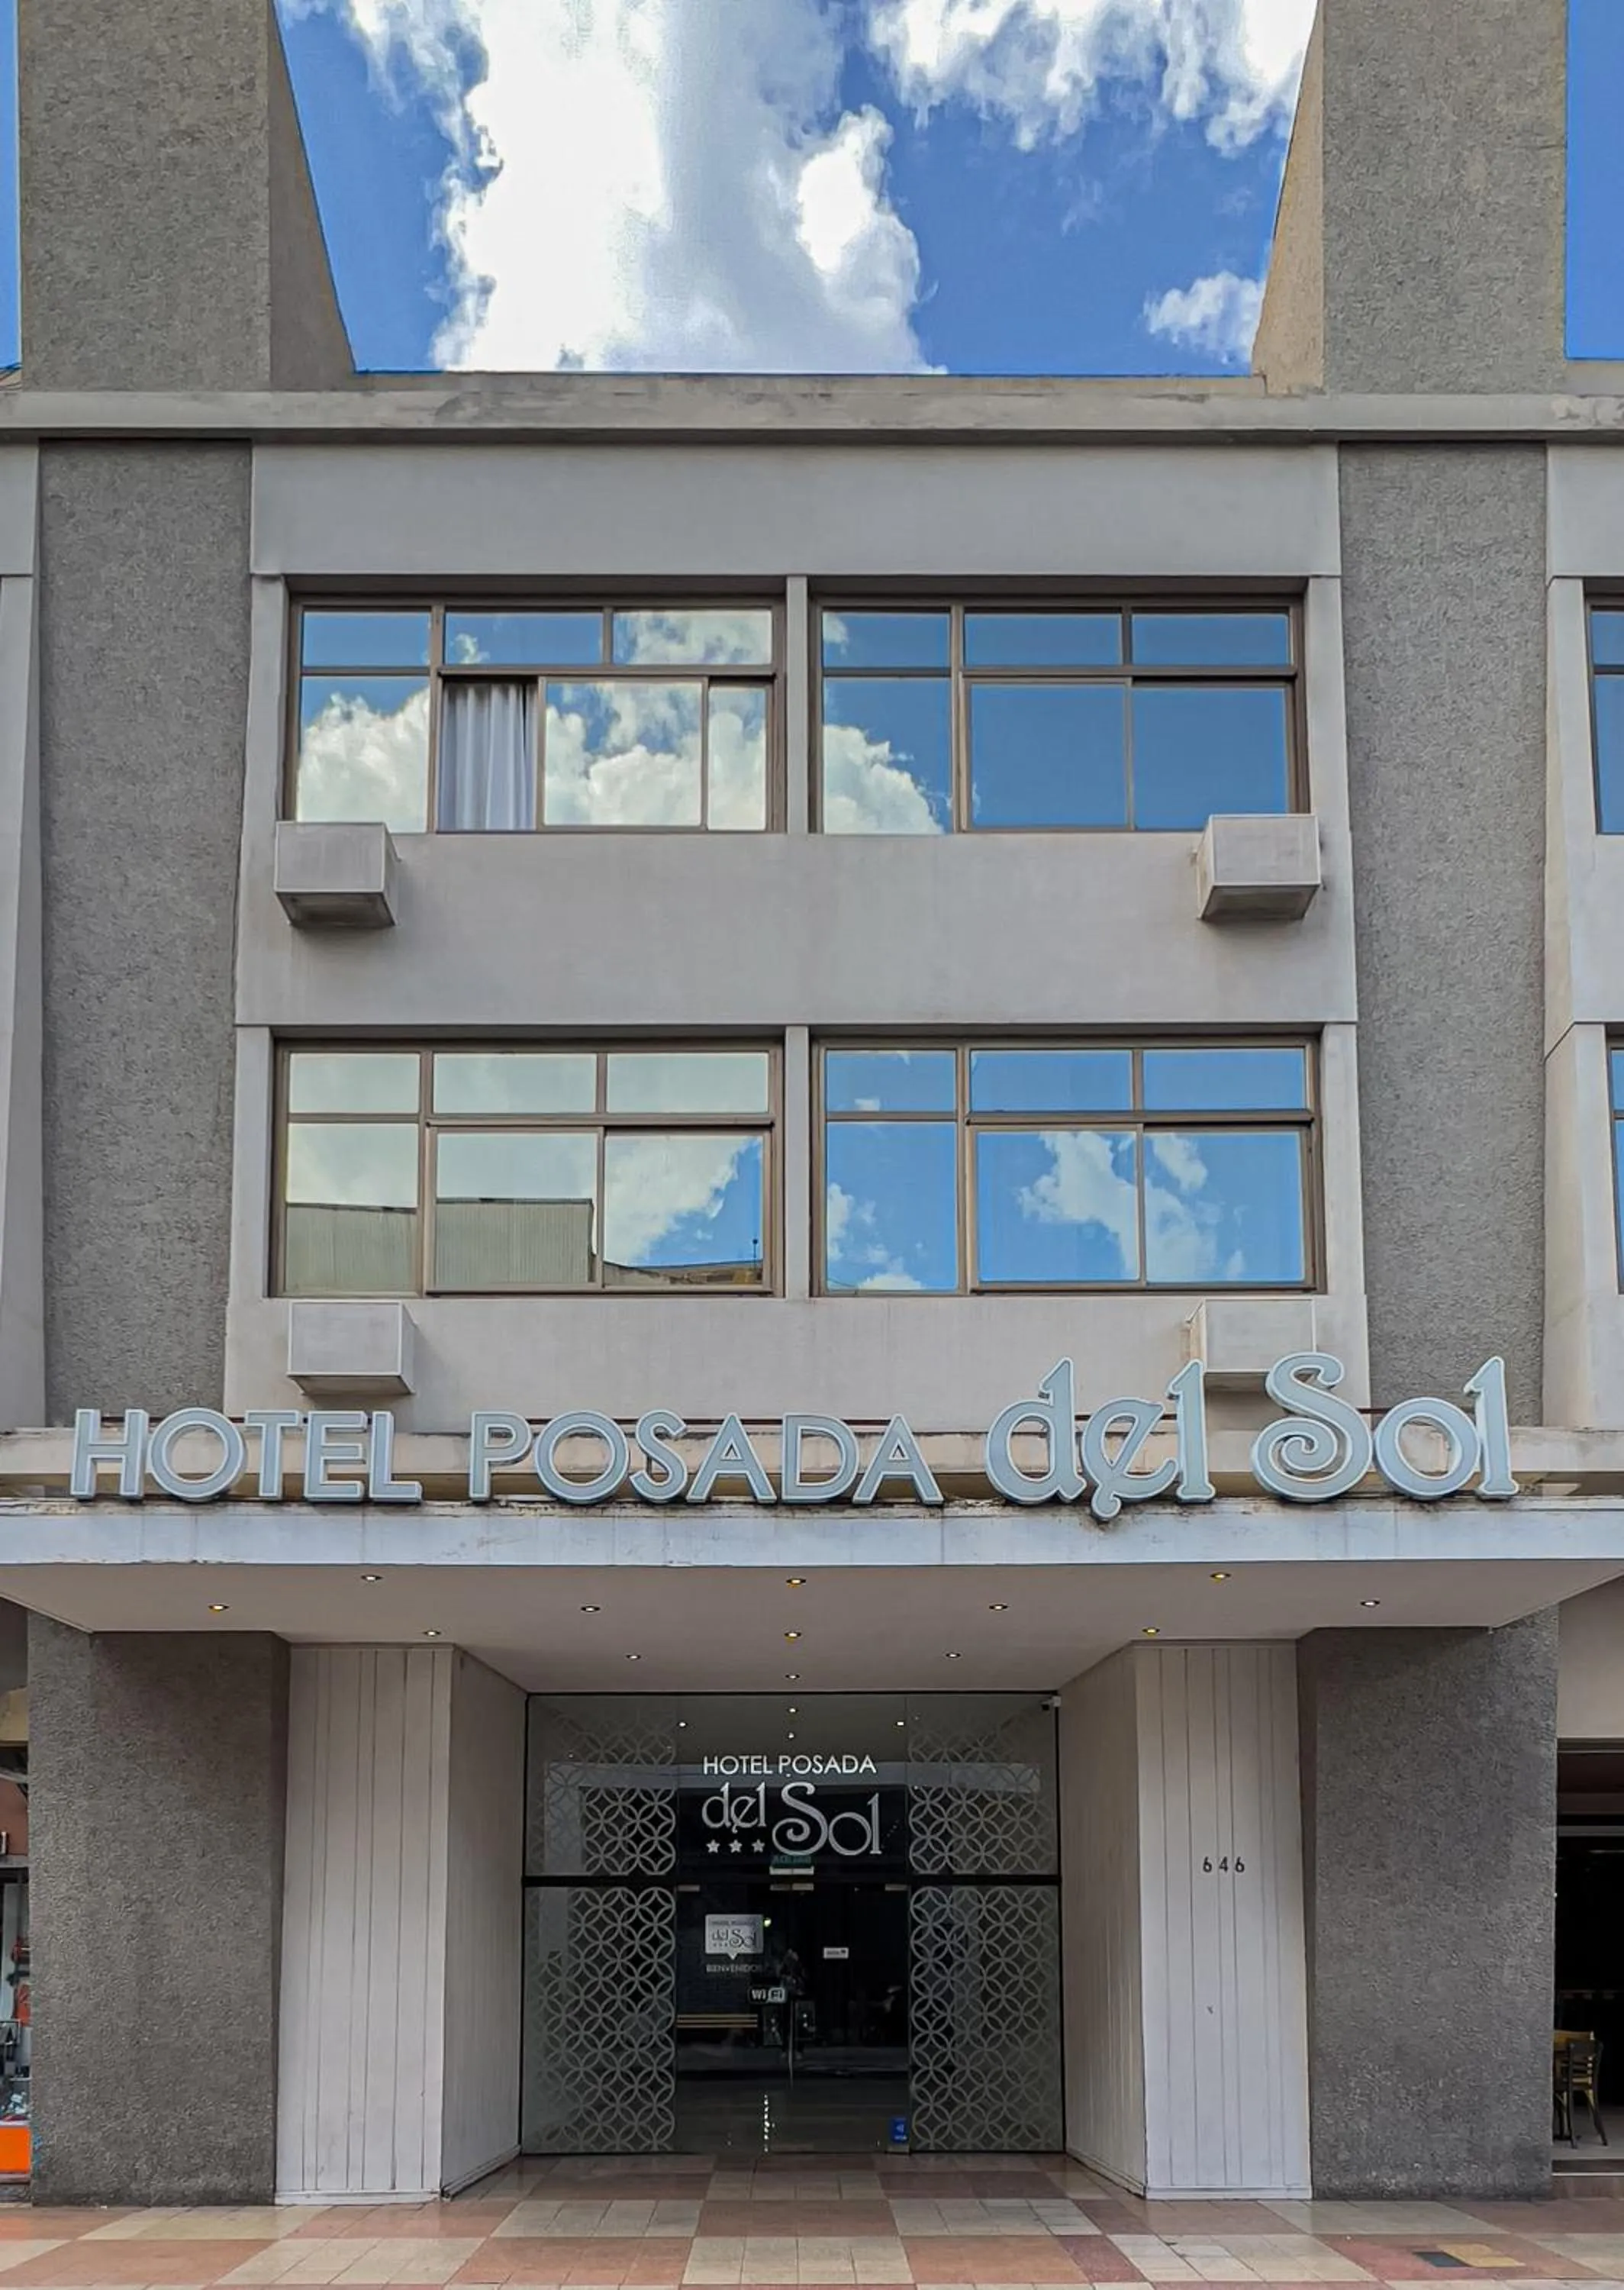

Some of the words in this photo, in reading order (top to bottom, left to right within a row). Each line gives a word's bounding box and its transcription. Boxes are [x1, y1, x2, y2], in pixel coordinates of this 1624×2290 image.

[69, 1408, 422, 1502] HOTEL
[469, 1409, 944, 1505] POSADA
[985, 1357, 1216, 1524] del
[1250, 1352, 1520, 1503] Sol
[703, 1756, 772, 1775] HOTEL
[779, 1755, 877, 1774] POSADA
[701, 1782, 767, 1834] del
[772, 1781, 883, 1856] Sol
[1203, 1856, 1245, 1873] 646
